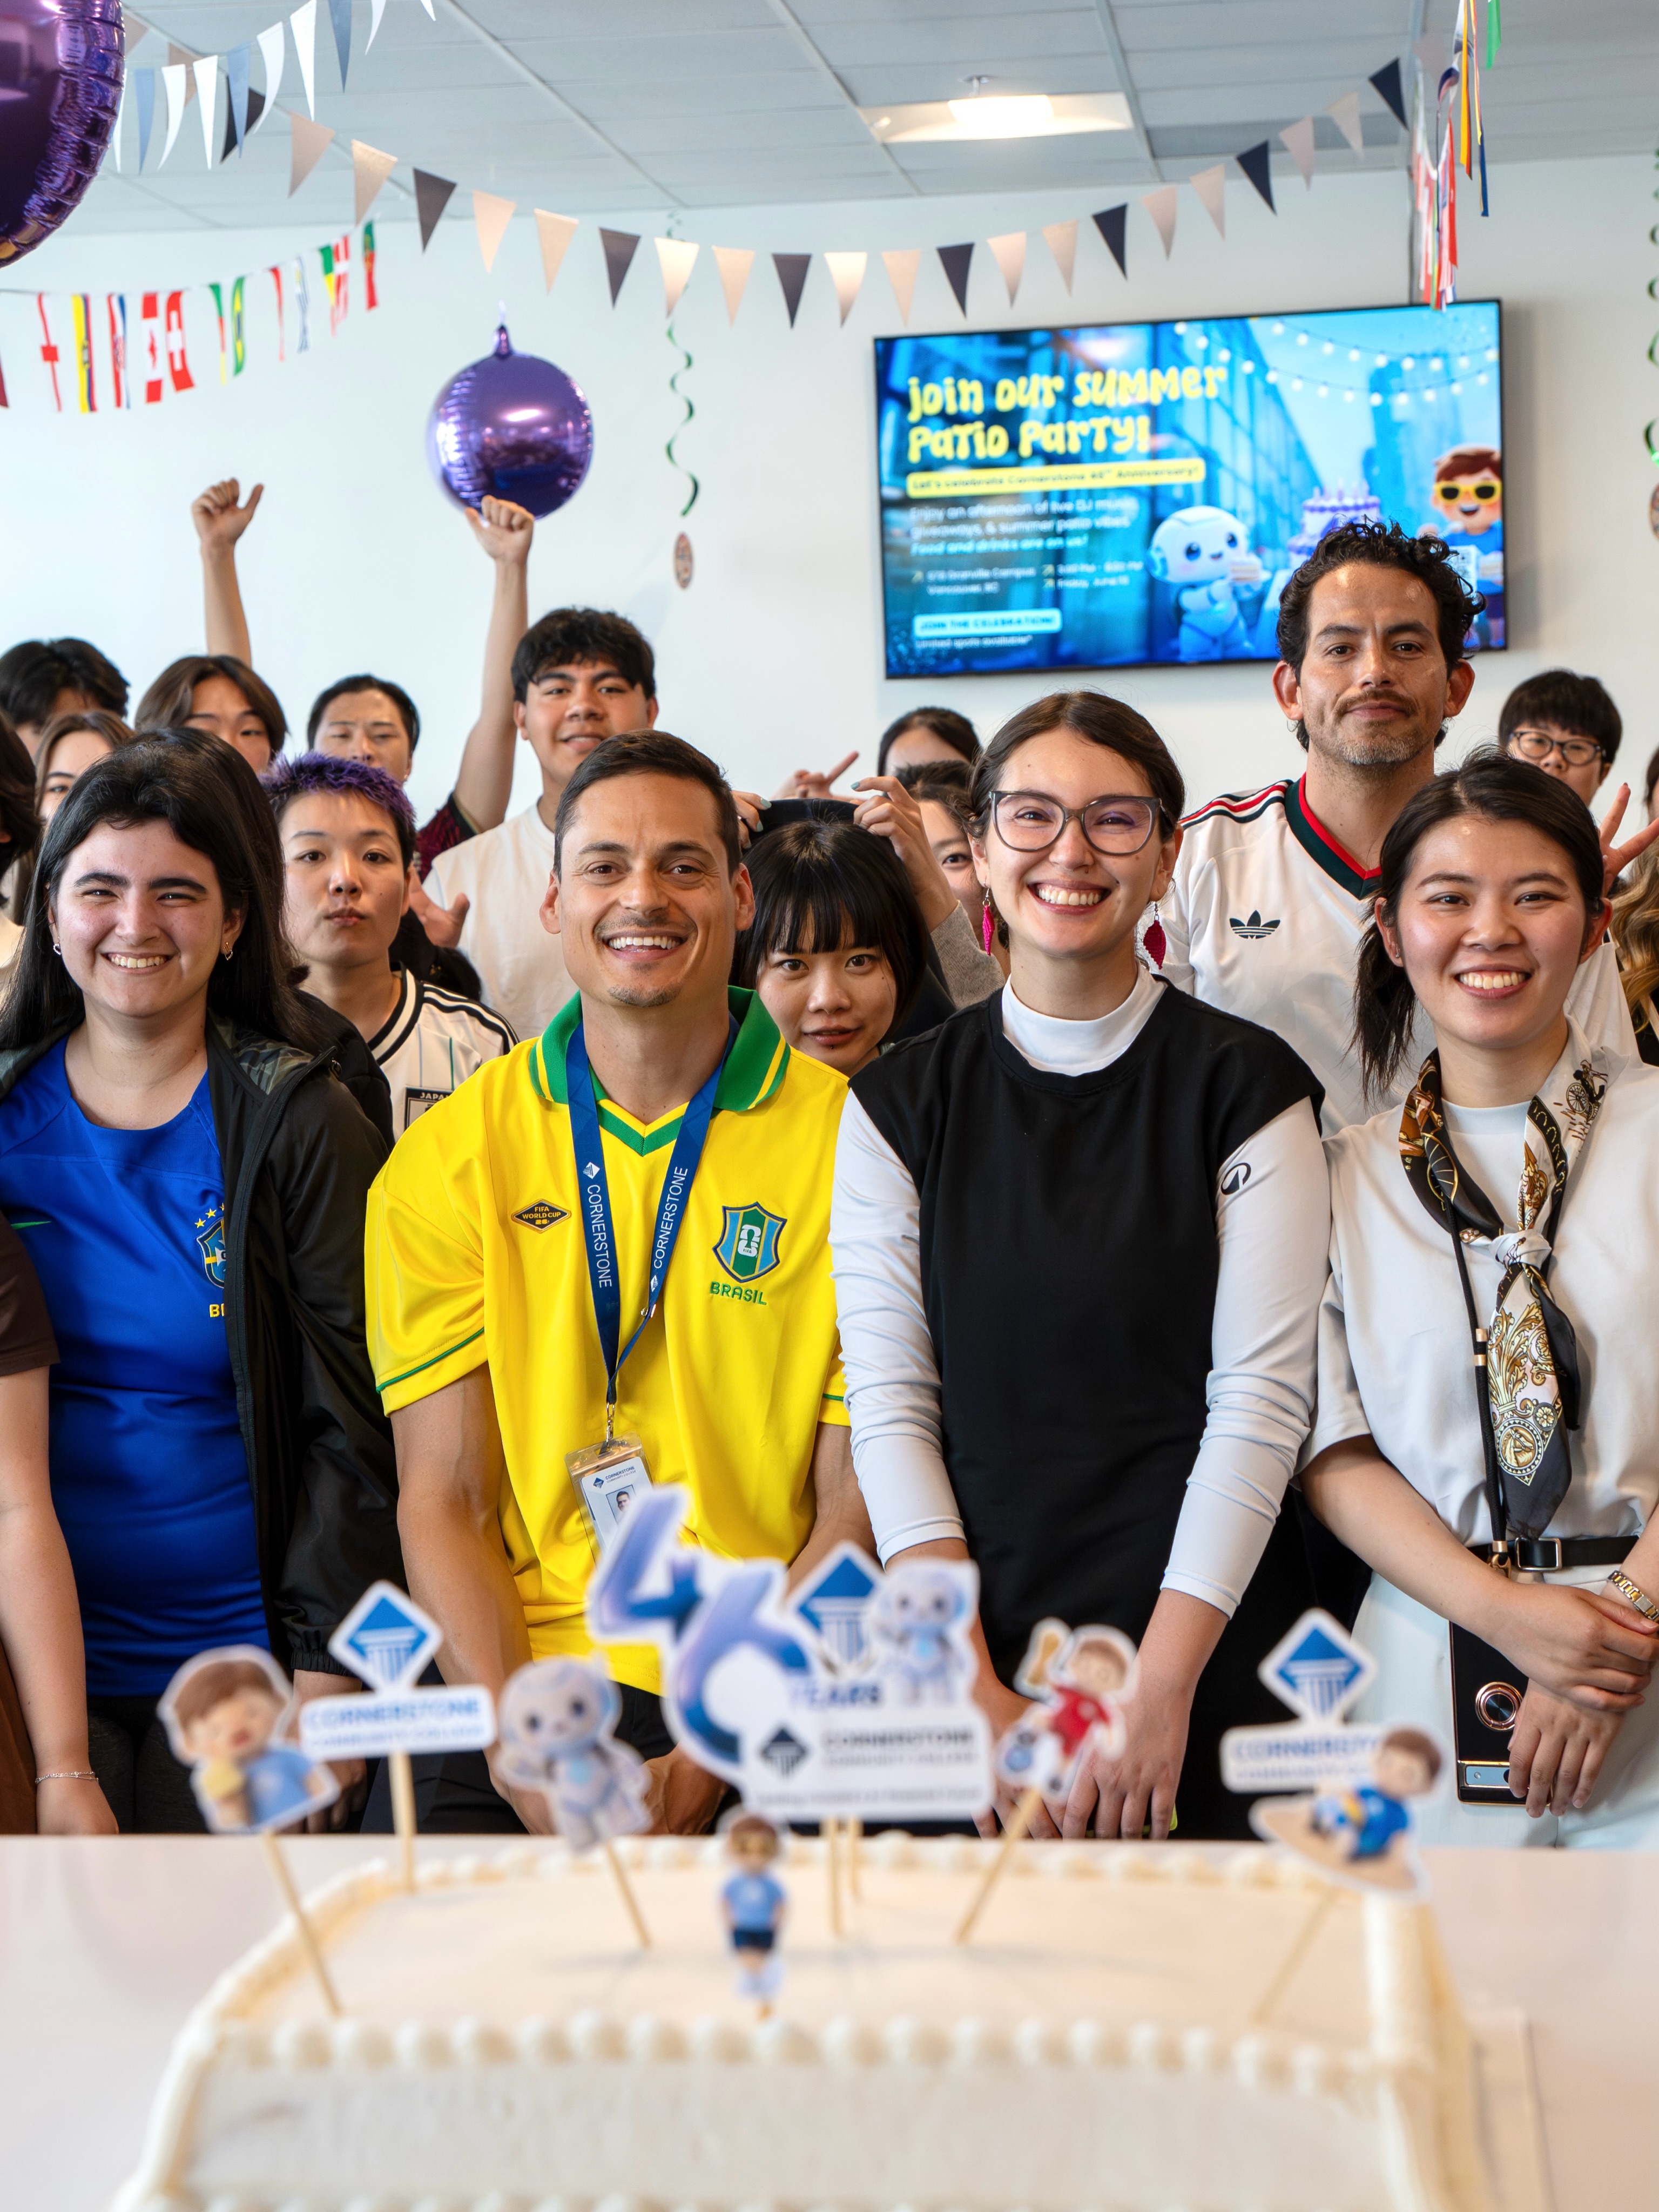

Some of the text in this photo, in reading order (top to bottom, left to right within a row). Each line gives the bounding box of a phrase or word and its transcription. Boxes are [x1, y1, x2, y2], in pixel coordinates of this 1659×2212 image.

[420, 1092, 449, 1100] JAPA
[654, 1166, 688, 1269] CORNERSTONE
[588, 1184, 612, 1288] CORNERSTONE
[710, 1281, 766, 1305] BRASIL
[605, 1466, 635, 1480] CORNERSTONE
